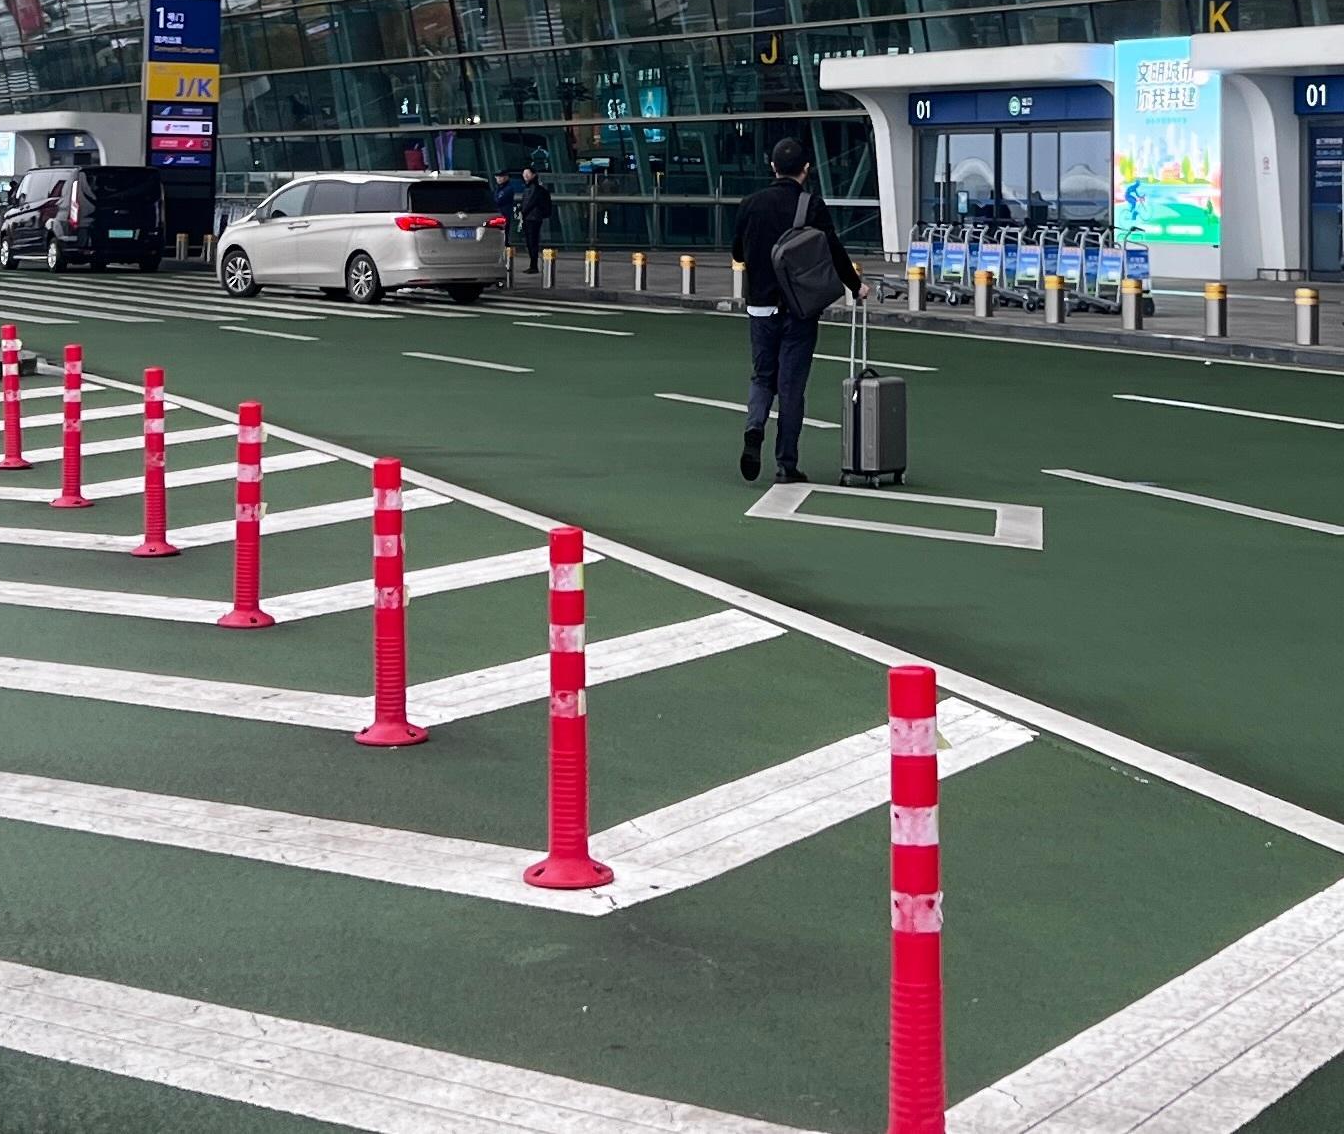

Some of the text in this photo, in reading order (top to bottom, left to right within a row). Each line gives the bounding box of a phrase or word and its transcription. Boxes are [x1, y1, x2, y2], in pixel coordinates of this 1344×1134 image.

[155, 6, 165, 29] 1
[1208, 0, 1232, 34] K
[760, 33, 778, 65] J
[1137, 60, 1194, 83] 文明城市
[175, 77, 213, 98] J/K
[1136, 86, 1197, 109] 你我共建
[1305, 83, 1327, 107] 01
[916, 100, 931, 120] 01
